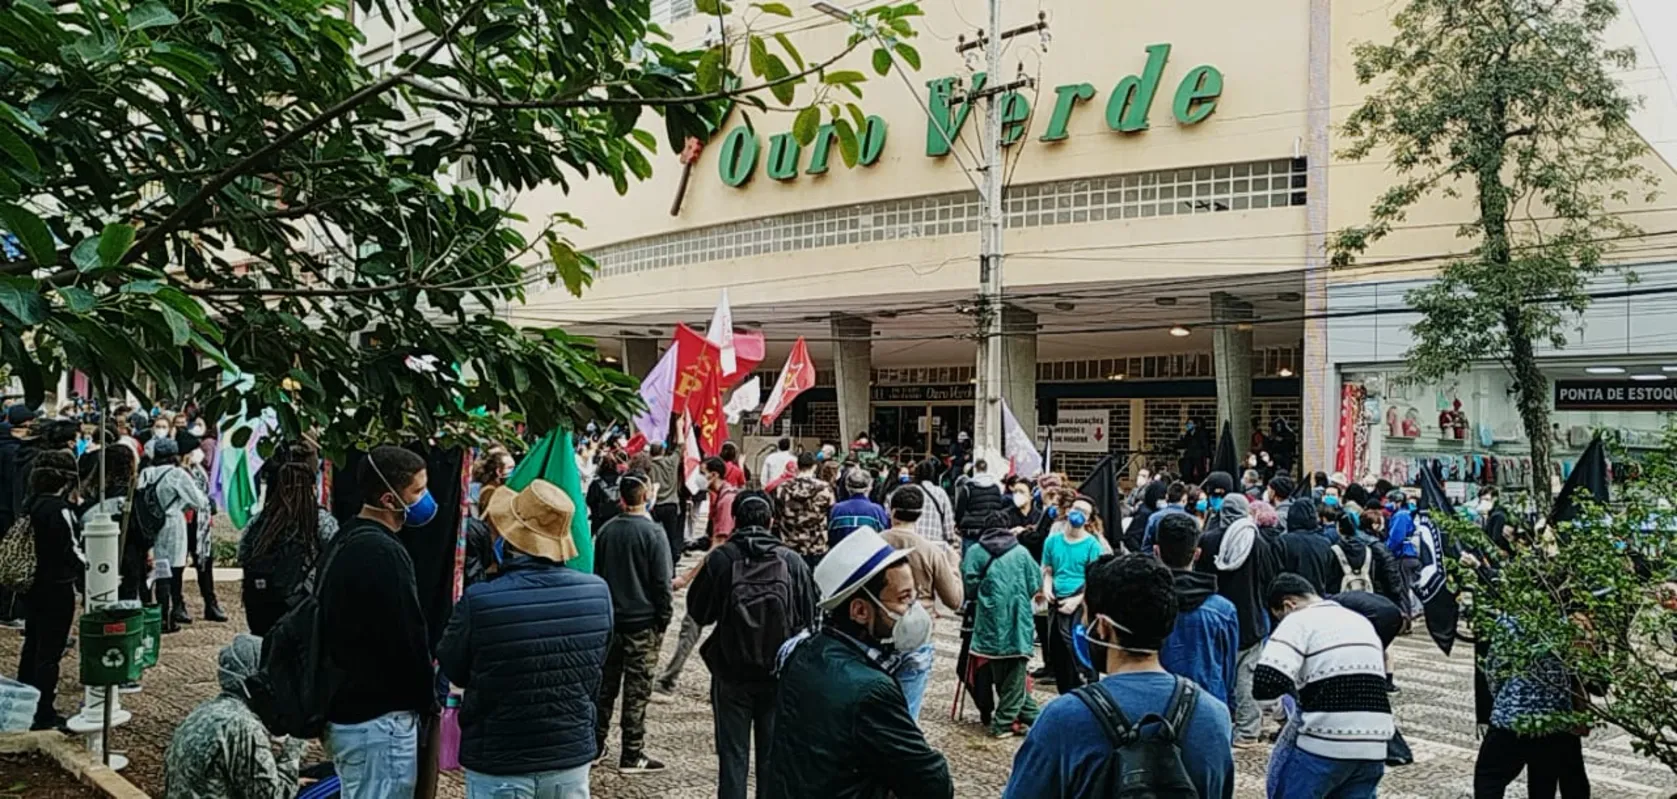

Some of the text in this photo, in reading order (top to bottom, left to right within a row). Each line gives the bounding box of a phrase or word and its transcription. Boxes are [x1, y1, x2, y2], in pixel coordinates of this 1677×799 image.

[719, 43, 1224, 187] Ouro Verde
[949, 385, 973, 398] Verd
[1559, 388, 1603, 401] PONTA
[1607, 388, 1624, 401] DE
[1075, 416, 1104, 425] DOAÇÕES
